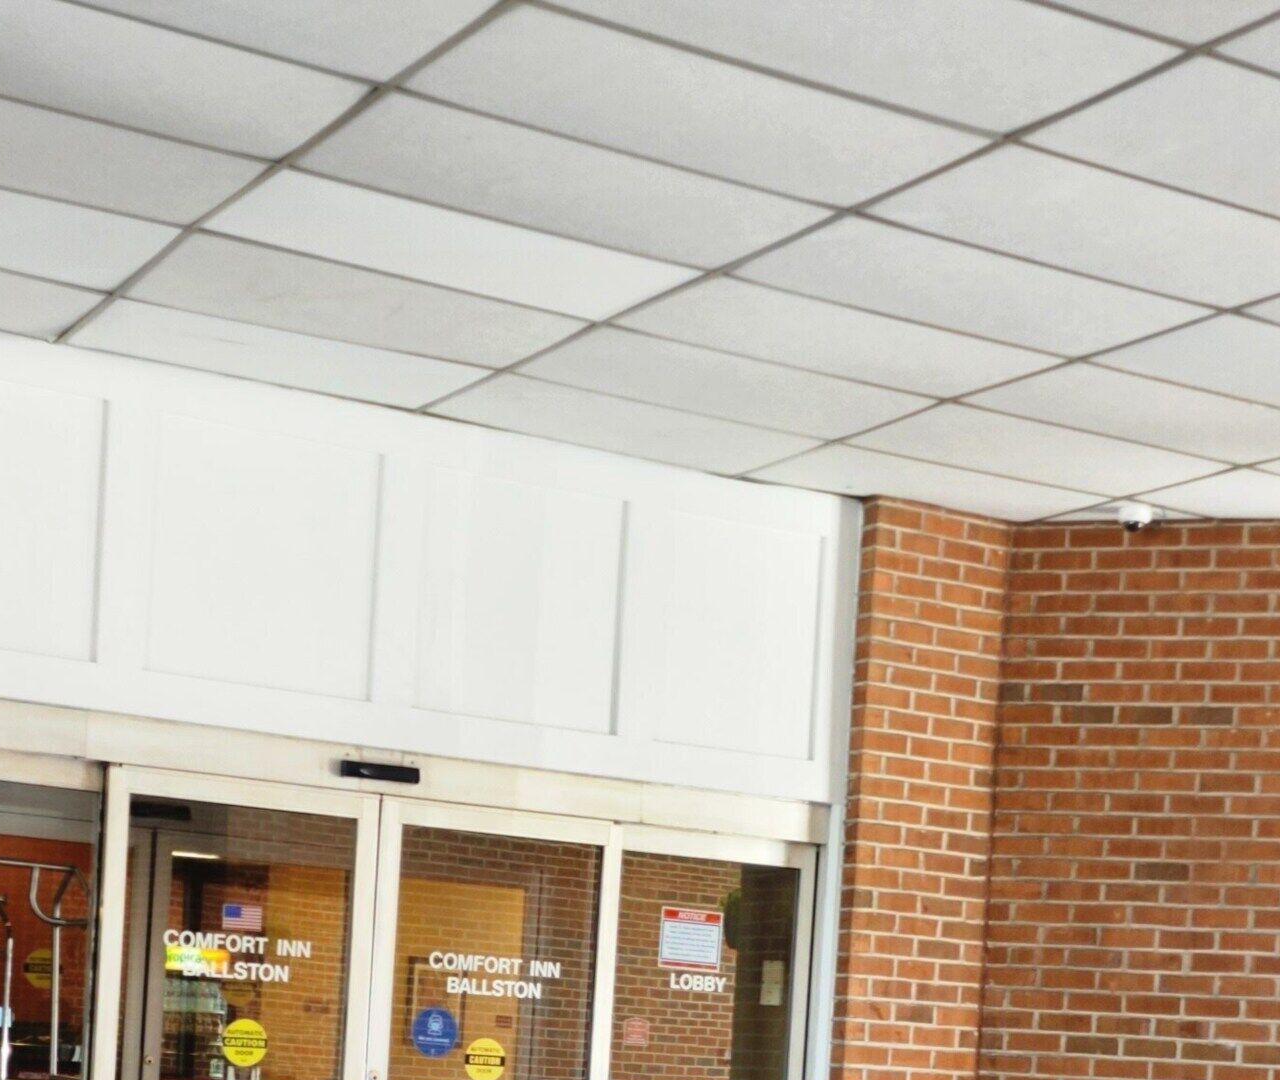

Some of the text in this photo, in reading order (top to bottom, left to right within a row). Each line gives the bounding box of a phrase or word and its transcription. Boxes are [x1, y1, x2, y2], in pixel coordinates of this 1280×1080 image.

[163, 929, 311, 958] COMFORT INN
[182, 959, 289, 982] BALLSTON
[429, 951, 561, 978] COMFORT INN
[446, 976, 542, 999] BALLSTON
[670, 973, 726, 992] LOBBY
[224, 1038, 265, 1047] CAUTION
[469, 1055, 501, 1065] CAUTION
